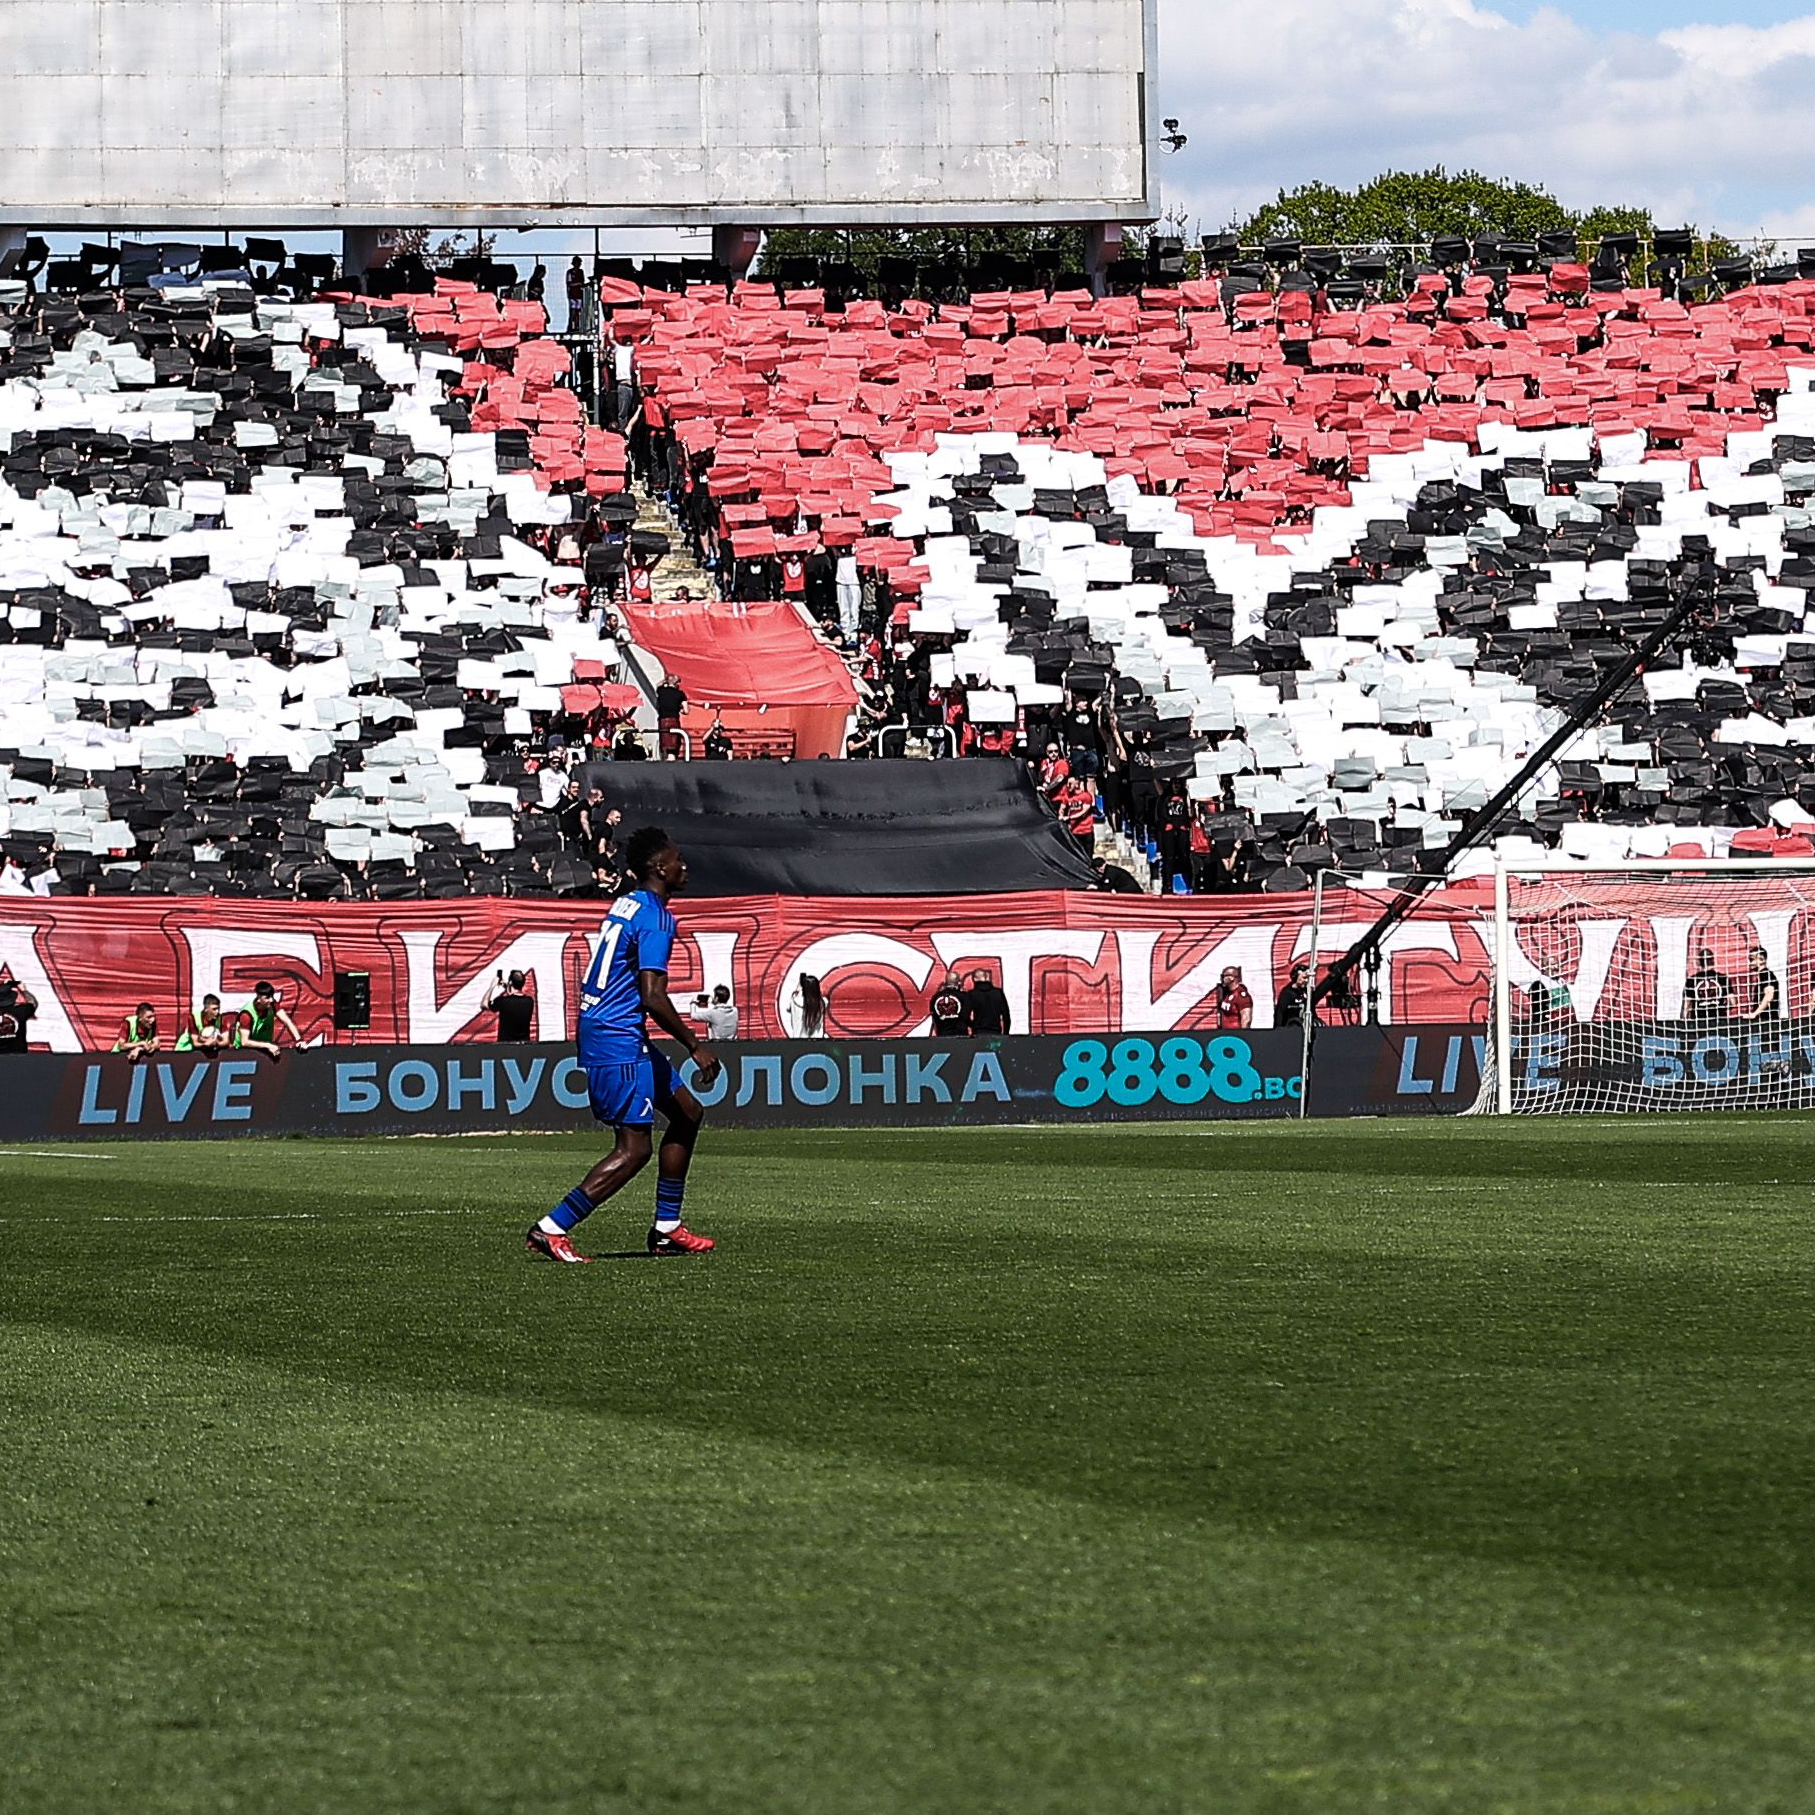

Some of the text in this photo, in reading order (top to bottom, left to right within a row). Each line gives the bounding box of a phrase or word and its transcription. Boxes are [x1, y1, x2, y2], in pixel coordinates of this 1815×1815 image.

[78, 1060, 258, 1125] LIVE
[335, 1051, 1012, 1115] БОНУС ОЛОНКА
